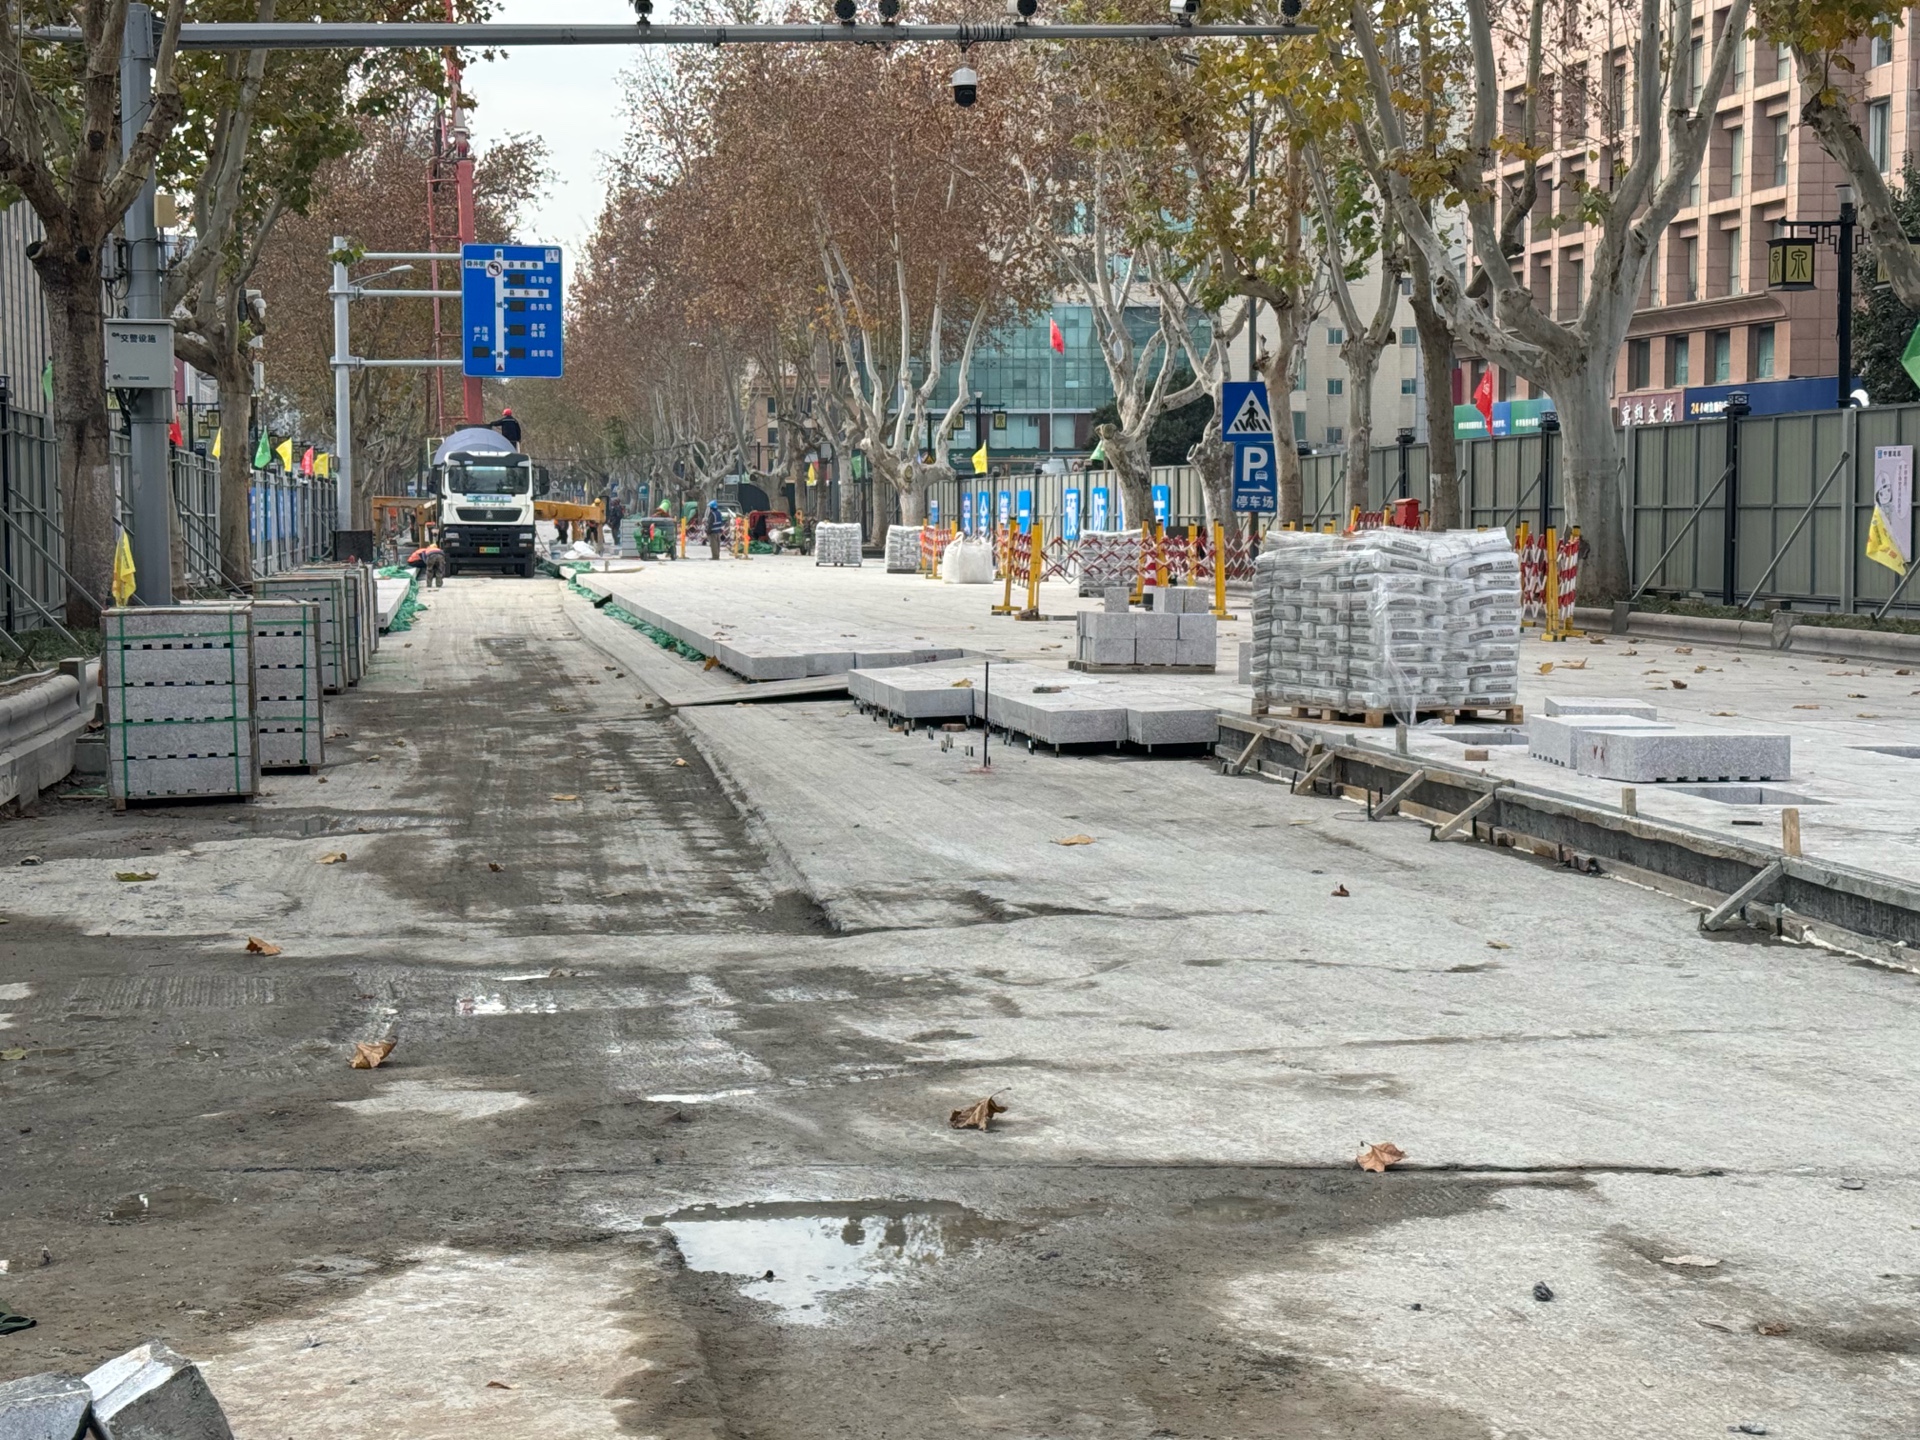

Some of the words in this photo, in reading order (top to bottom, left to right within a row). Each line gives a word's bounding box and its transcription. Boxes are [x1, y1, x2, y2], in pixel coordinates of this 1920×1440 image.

[120, 334, 157, 343] 交警设施
[1243, 447, 1268, 482] P
[1236, 495, 1274, 509] 停车场
